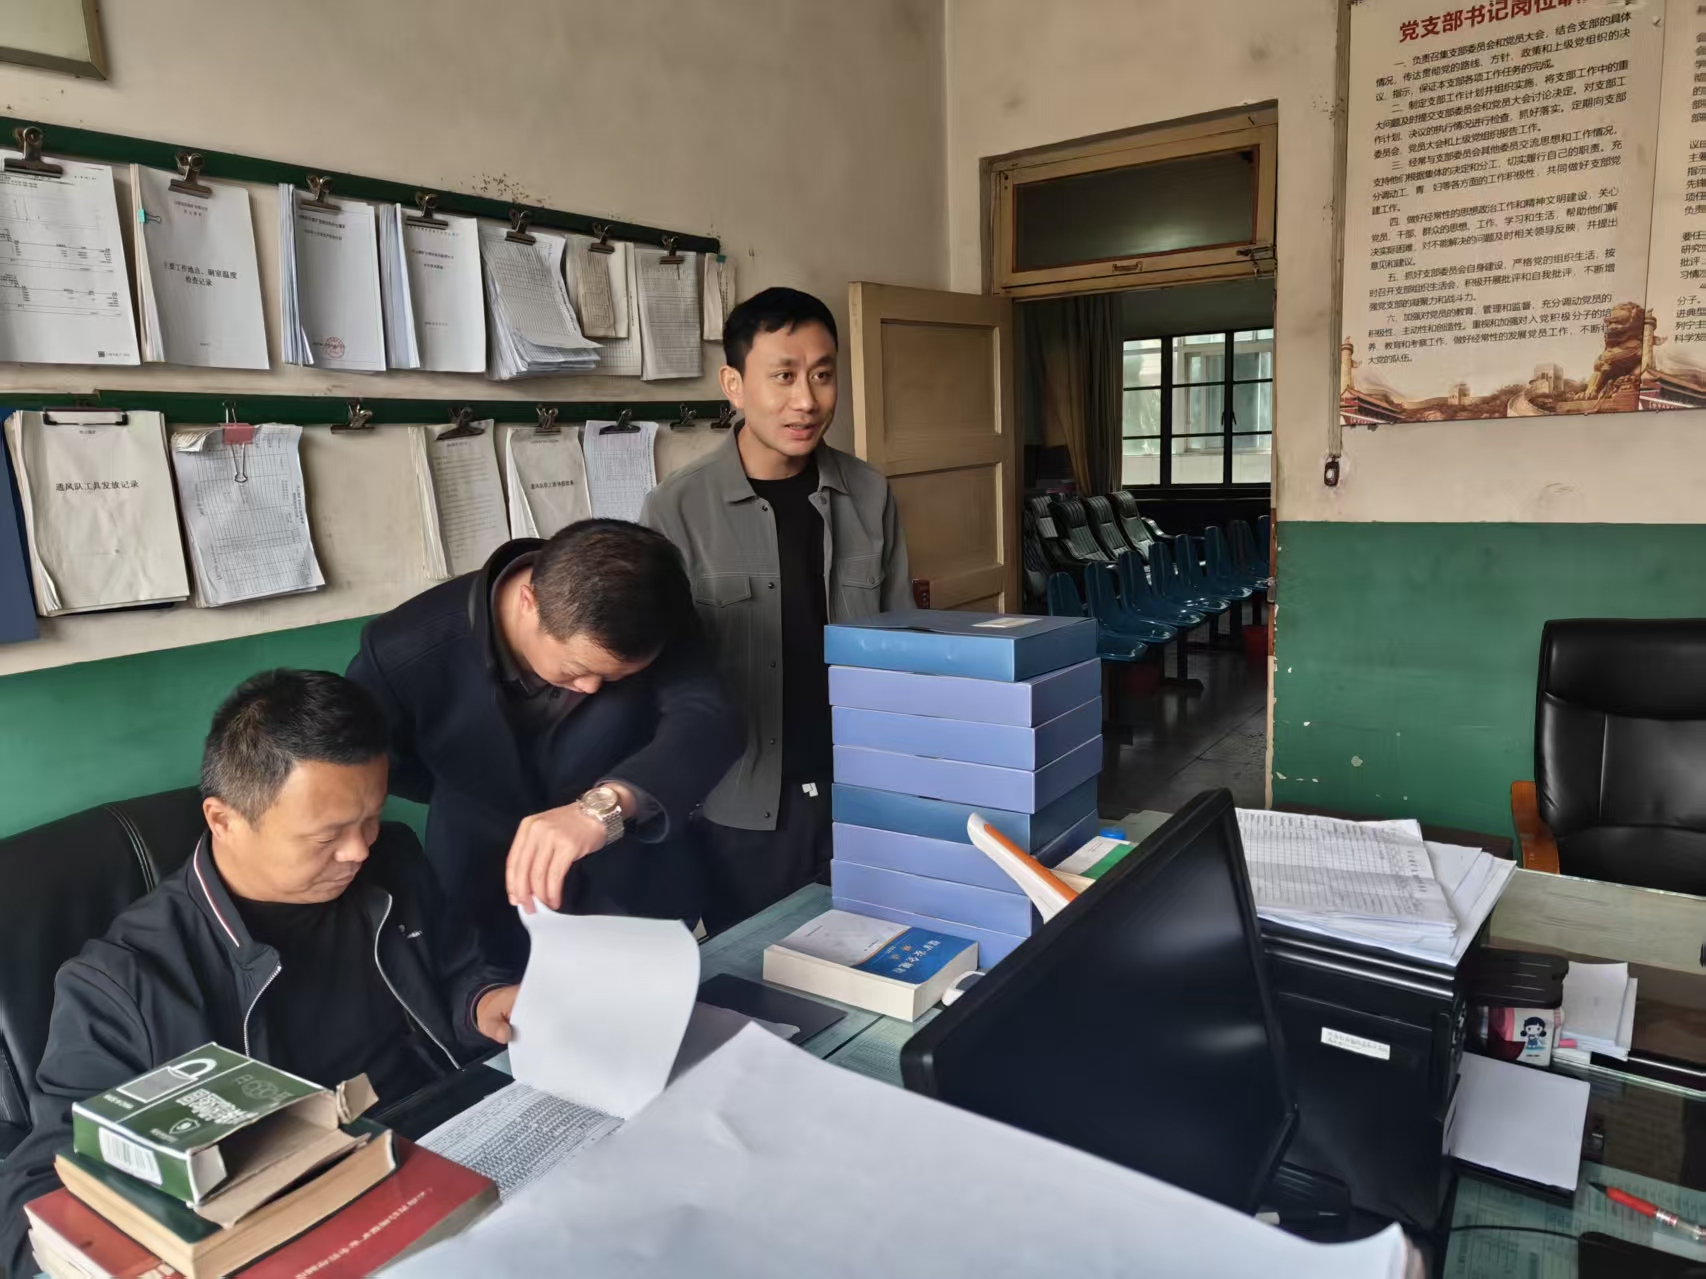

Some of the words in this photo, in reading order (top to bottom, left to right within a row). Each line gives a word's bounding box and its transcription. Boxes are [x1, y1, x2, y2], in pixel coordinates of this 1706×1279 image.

[1399, 0, 1587, 43] 党支部书记岗位
